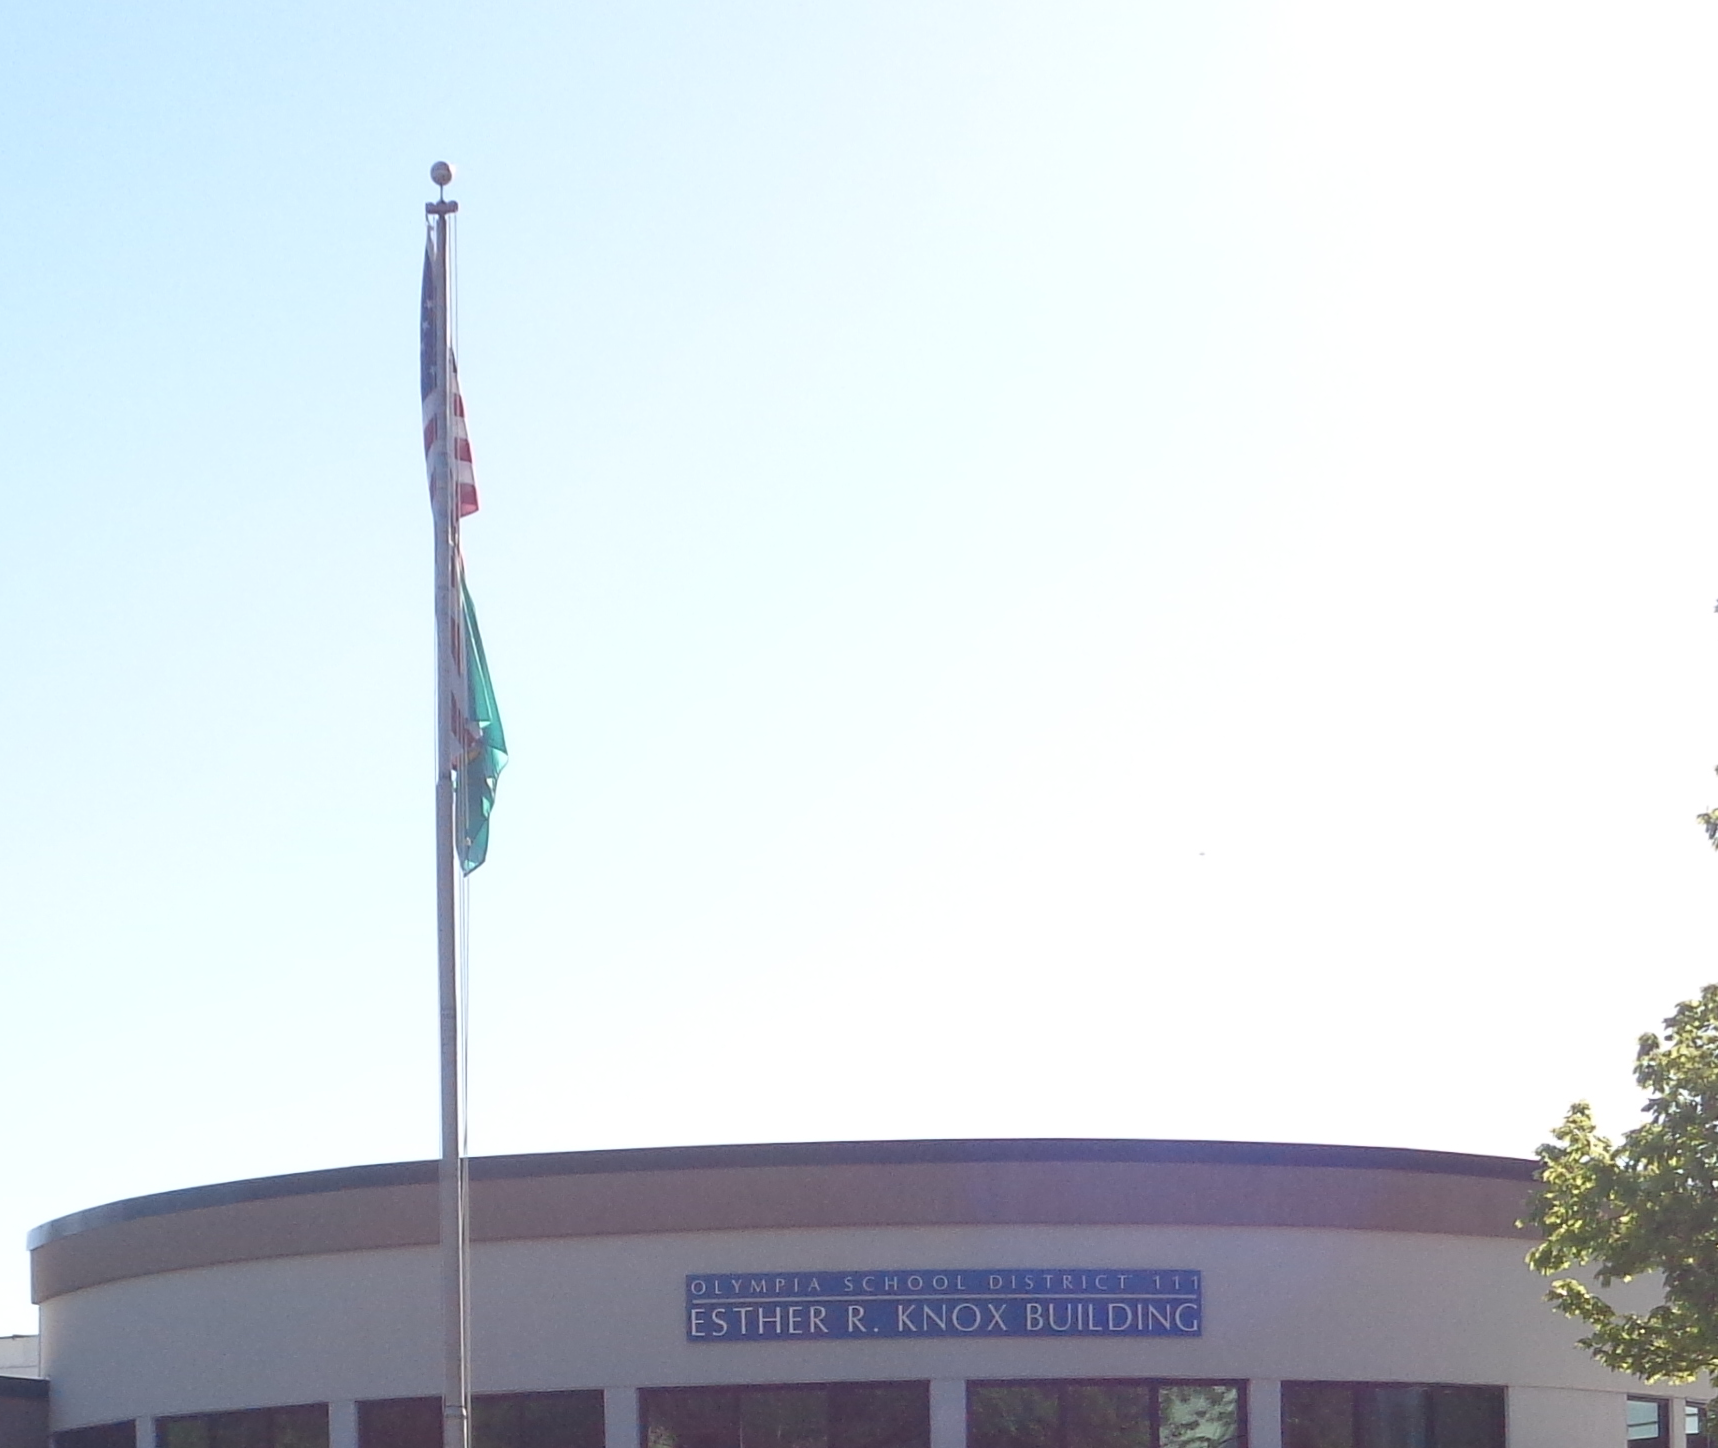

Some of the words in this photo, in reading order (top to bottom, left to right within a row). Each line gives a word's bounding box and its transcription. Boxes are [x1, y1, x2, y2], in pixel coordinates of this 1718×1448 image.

[691, 1277, 821, 1295] OLYMPIA
[844, 1275, 966, 1292] SCHOOL
[989, 1274, 1132, 1290] DISTRICT
[1152, 1275, 1199, 1290] 111
[690, 1305, 829, 1336] ESTHER
[847, 1304, 879, 1333] R.
[898, 1303, 1008, 1333] KNOX
[1026, 1303, 1199, 1332] BUILDING
